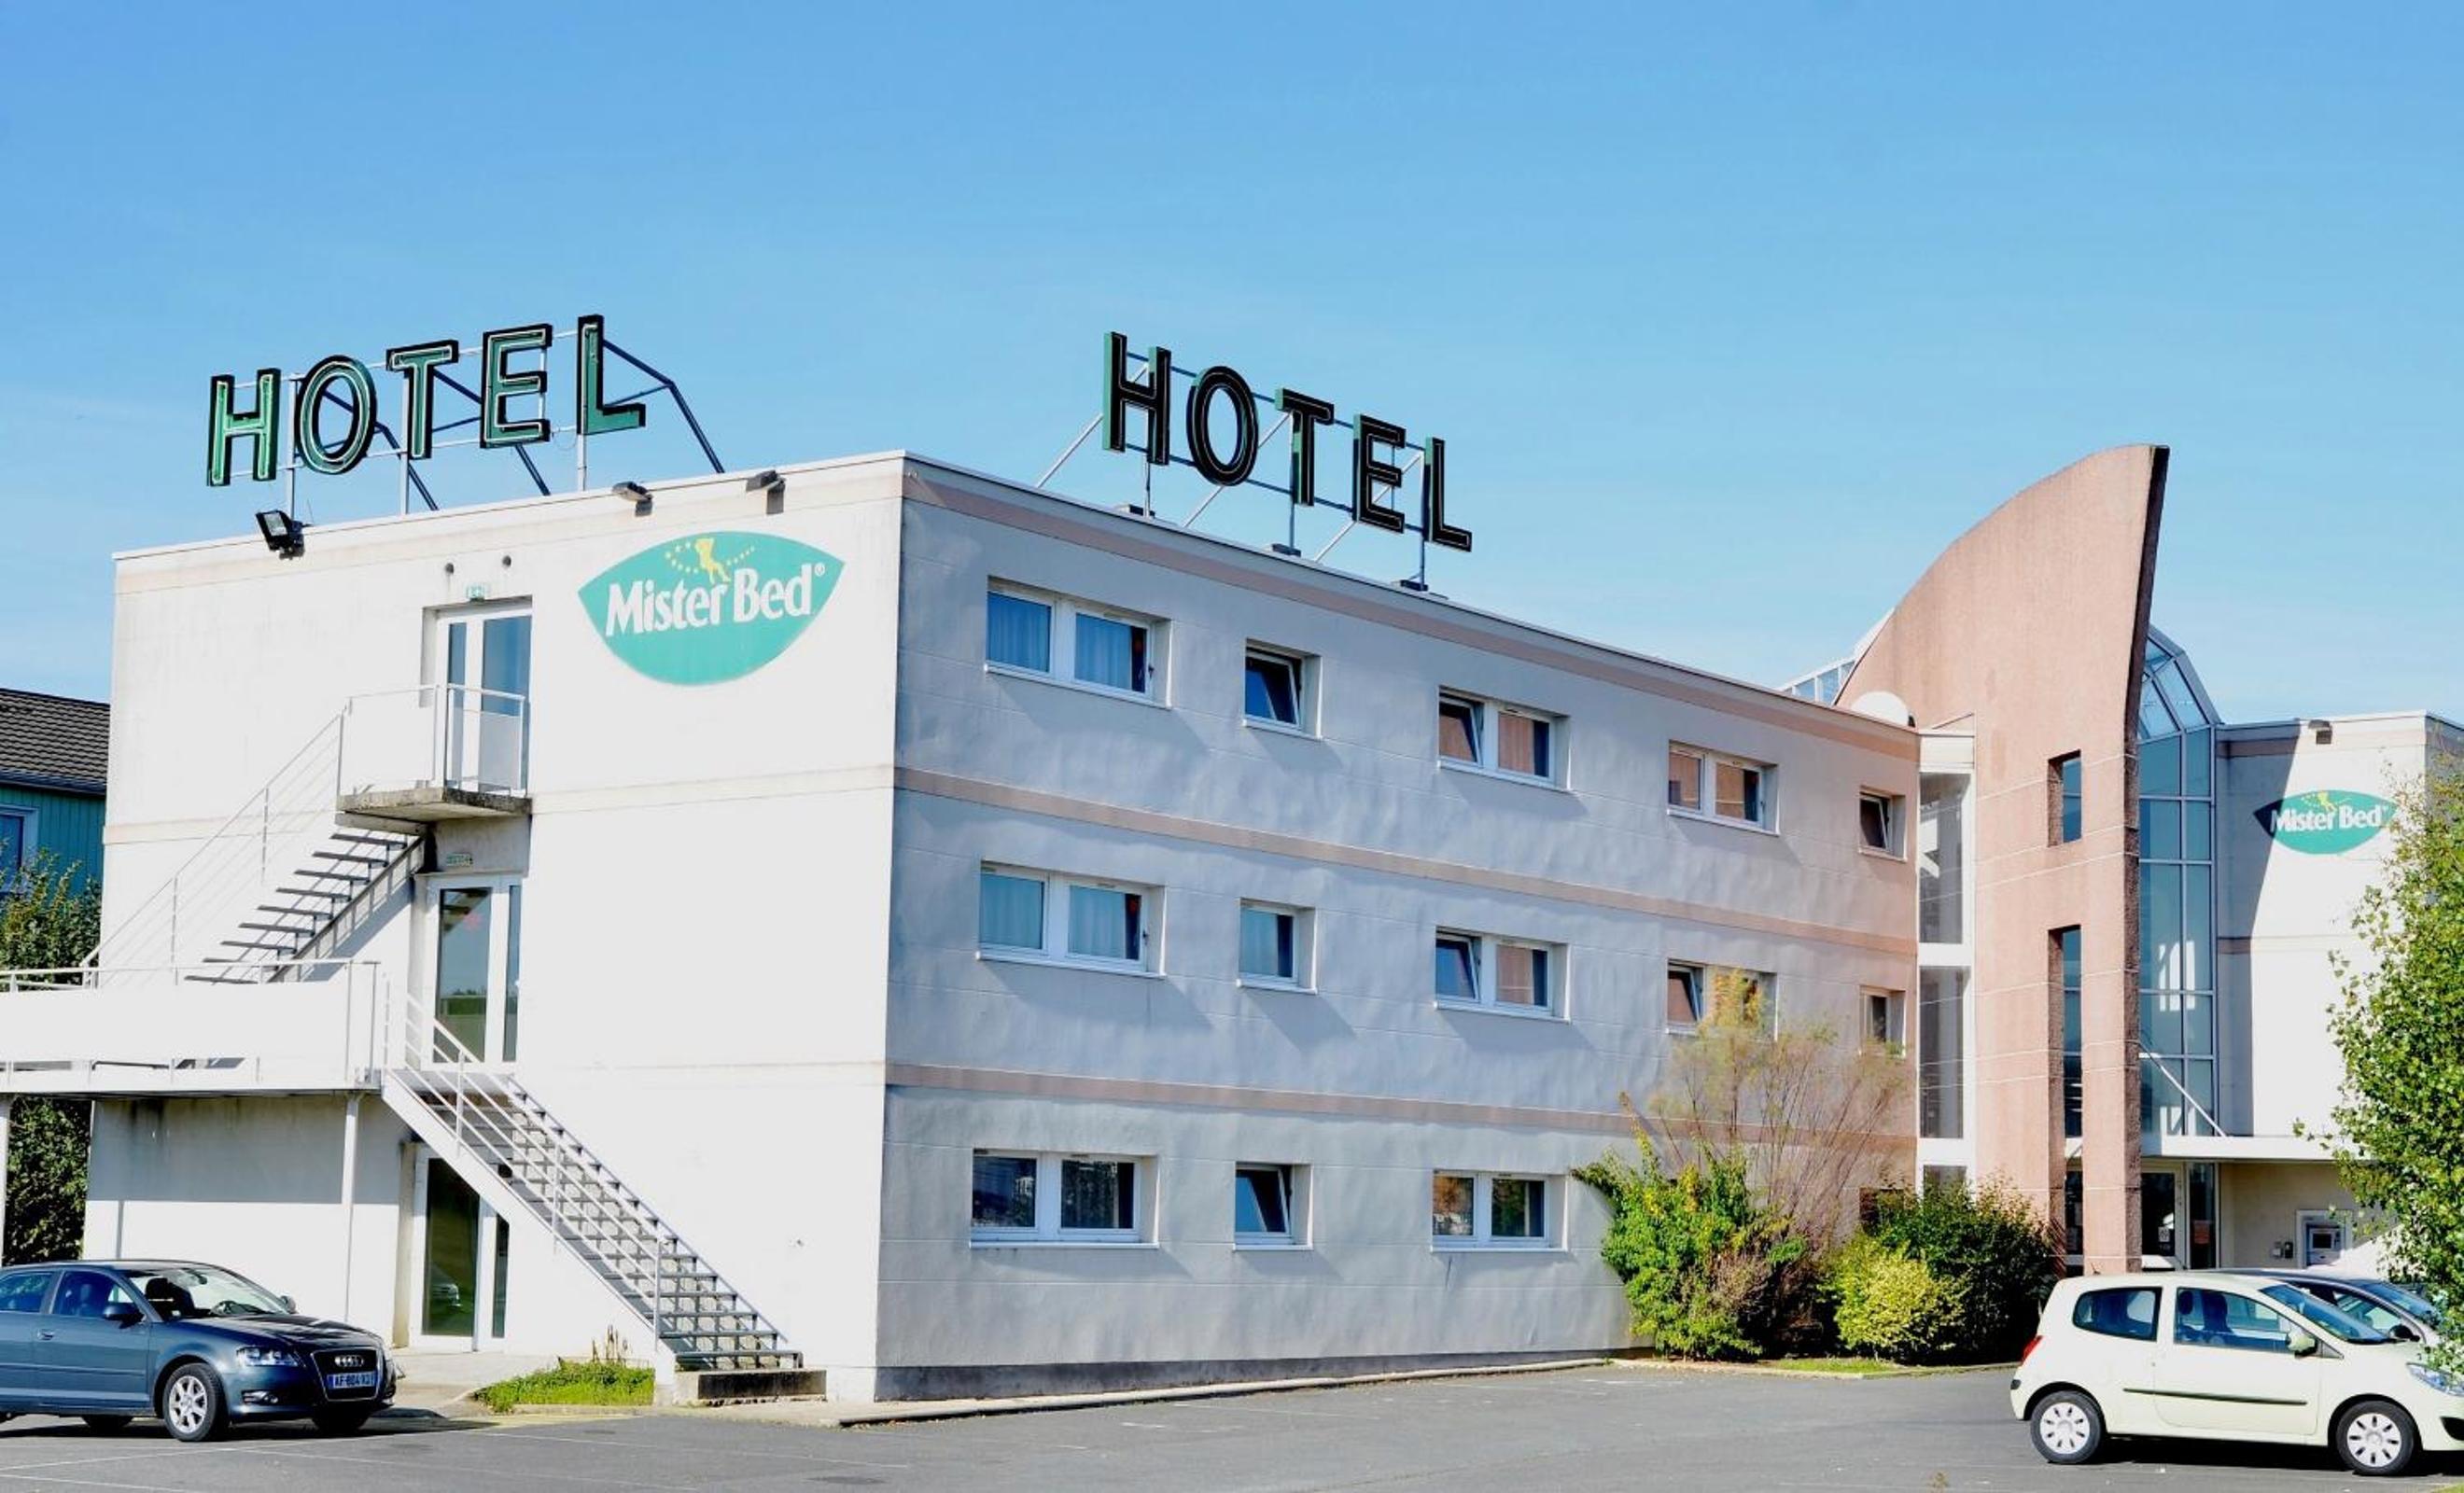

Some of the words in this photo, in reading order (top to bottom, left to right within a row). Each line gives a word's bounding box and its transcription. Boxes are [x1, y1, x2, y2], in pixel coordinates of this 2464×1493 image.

[206, 314, 646, 486] HOTEL
[1101, 331, 1473, 552] HOTEL
[605, 579, 728, 637] Mister
[2269, 807, 2334, 833] Mister
